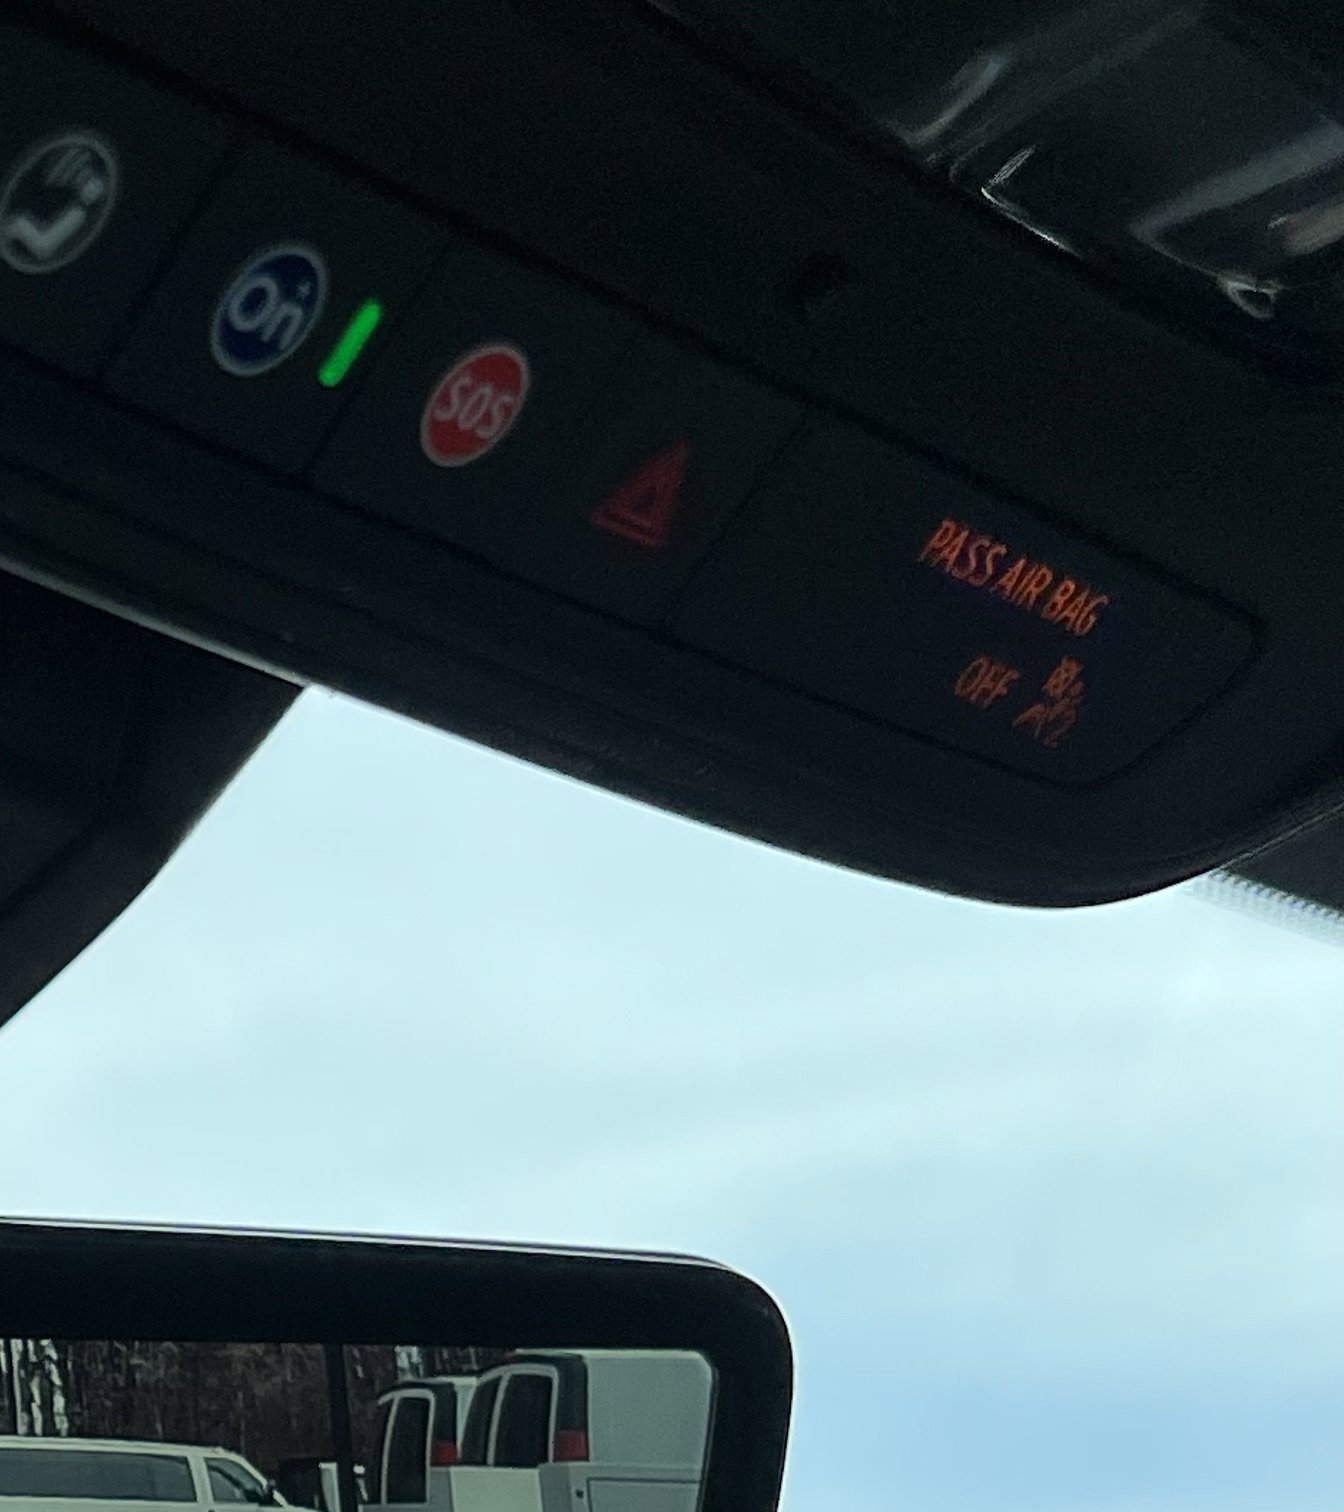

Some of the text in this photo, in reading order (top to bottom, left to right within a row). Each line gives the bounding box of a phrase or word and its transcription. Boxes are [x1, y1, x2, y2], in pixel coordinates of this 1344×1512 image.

[229, 274, 303, 350] On
[433, 375, 513, 440] SOS
[917, 516, 1110, 637] PASS AIR BAG
[954, 656, 1021, 709] OFF
